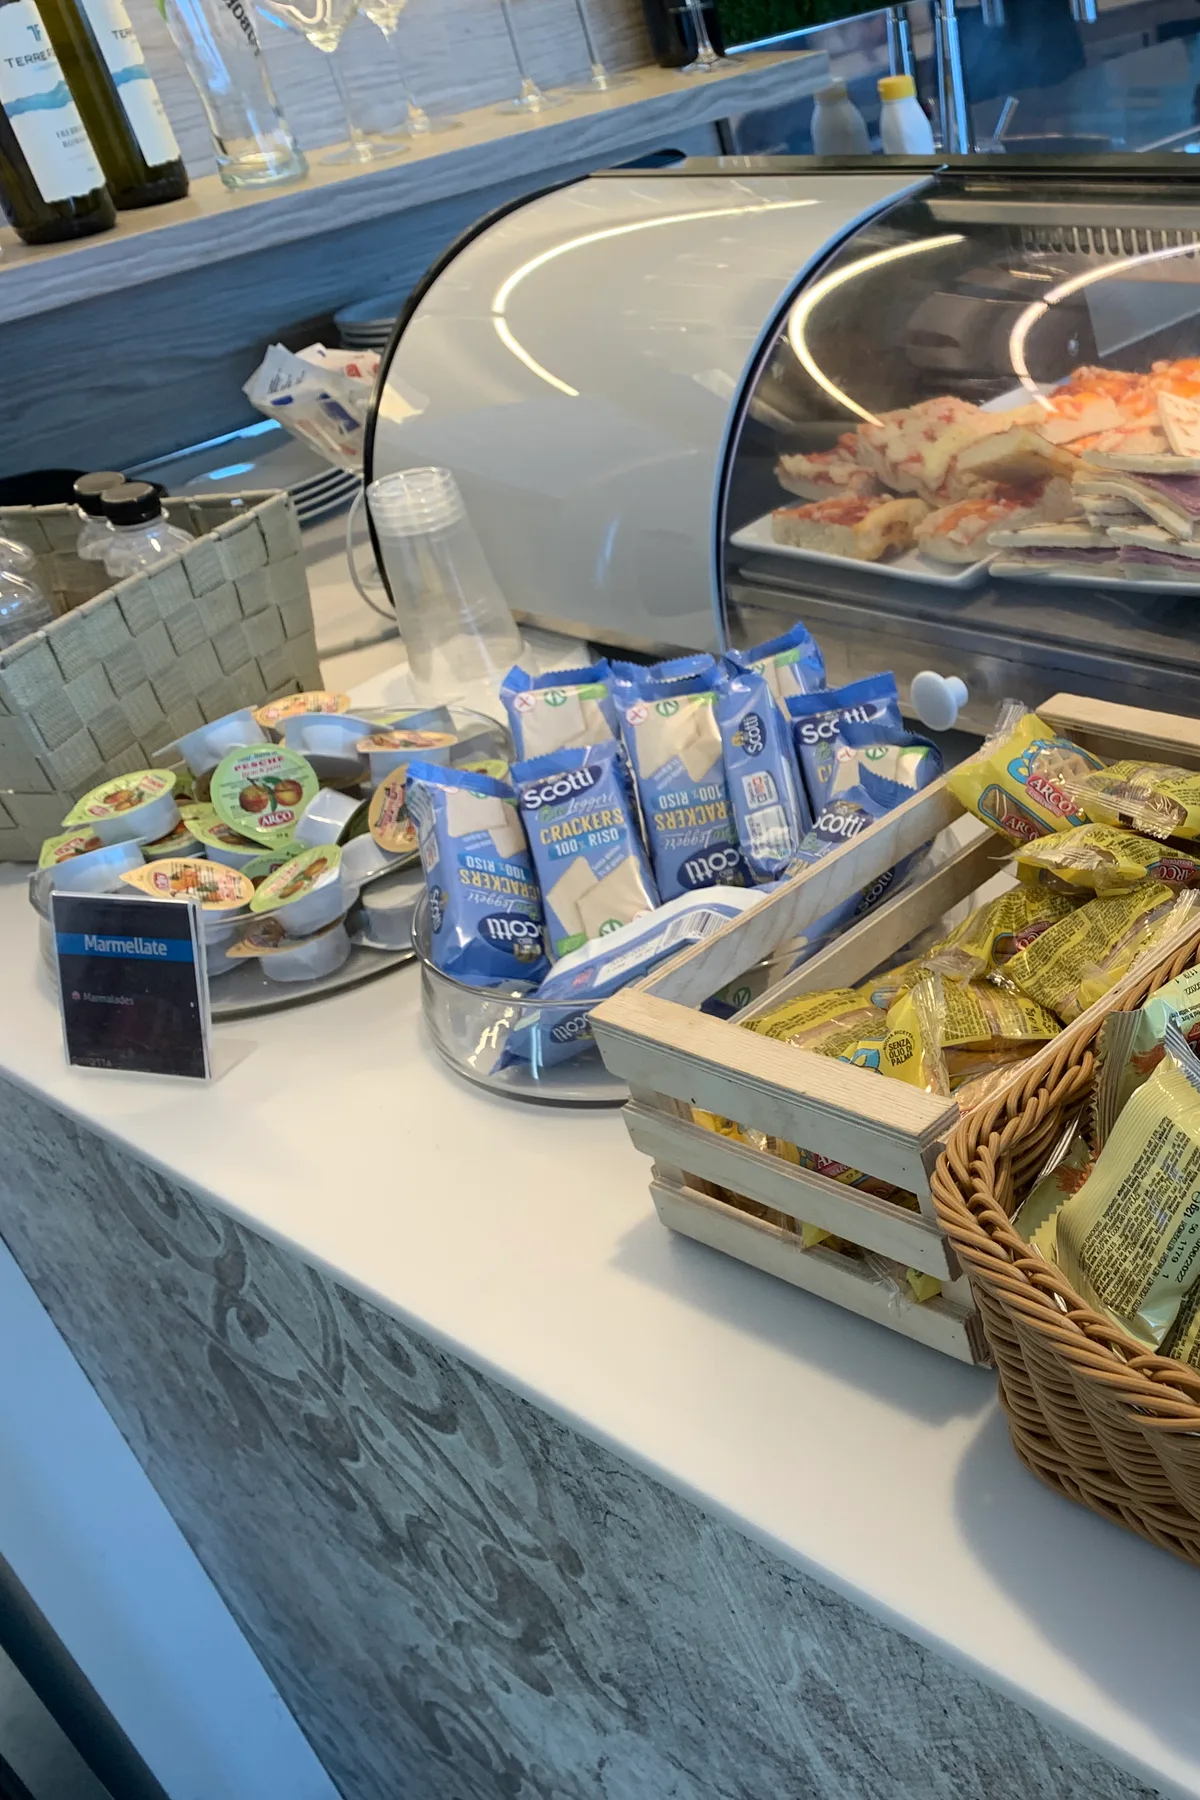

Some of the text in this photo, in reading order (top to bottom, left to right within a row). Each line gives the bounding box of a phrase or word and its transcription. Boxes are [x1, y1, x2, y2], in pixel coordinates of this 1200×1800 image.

[234, 756, 284, 771] PESCHE
[524, 768, 594, 808] Scotti
[1030, 778, 1071, 812] ARCO
[659, 792, 689, 810] RISO
[260, 811, 292, 827] ARCO
[654, 800, 731, 831] RACKERS
[540, 808, 624, 844] CRACKERS
[1007, 818, 1039, 841] ARCO
[588, 829, 619, 846] RISO
[466, 856, 495, 872] RISO
[84, 934, 168, 956] Marmellate
[84, 993, 134, 1005] Marmalades
[888, 1039, 911, 1051] SENZA
[889, 1045, 913, 1060] OLIO DI
[891, 1052, 913, 1066] PALMA
[1182, 1201, 1200, 1220] 12g
[1172, 1240, 1187, 1264] 1179
